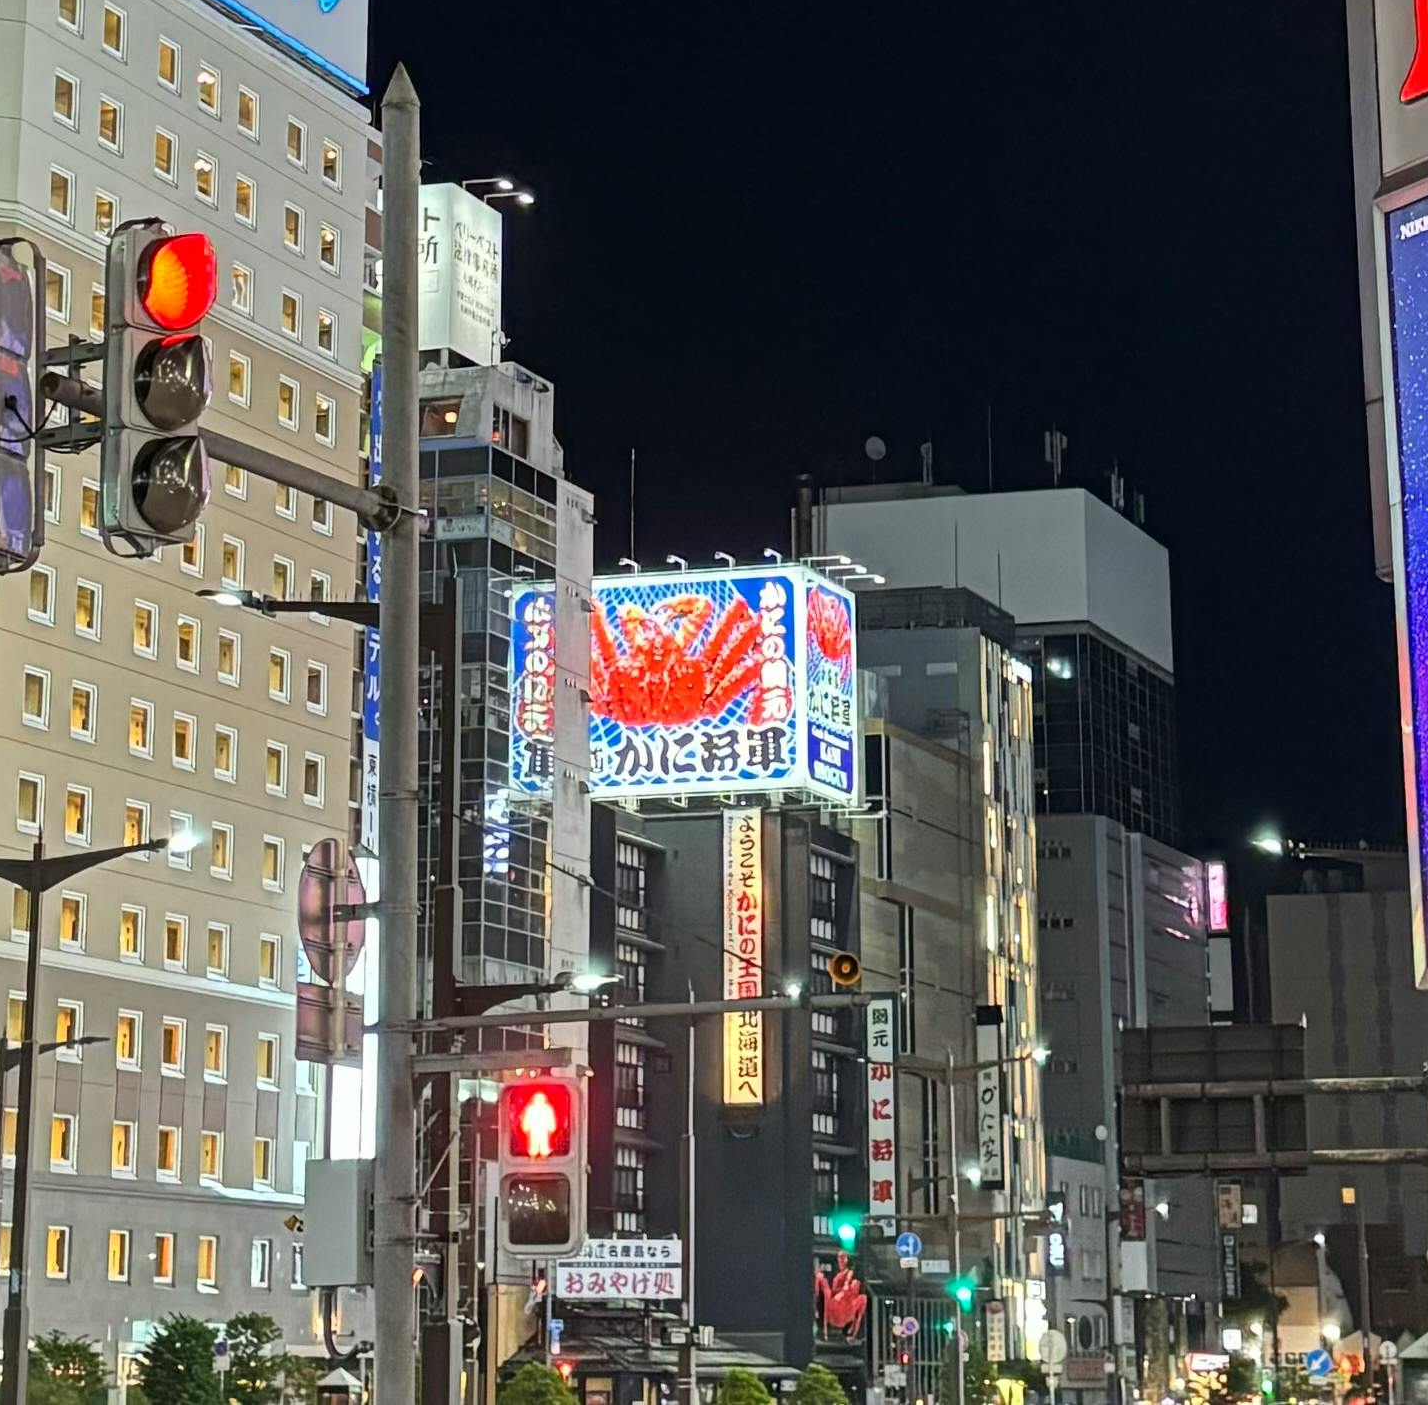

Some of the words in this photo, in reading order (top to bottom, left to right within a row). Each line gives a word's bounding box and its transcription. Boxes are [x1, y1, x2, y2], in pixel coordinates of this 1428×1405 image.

[615, 726, 787, 778] かに将軍
[565, 1271, 675, 1296] おみやげ処
